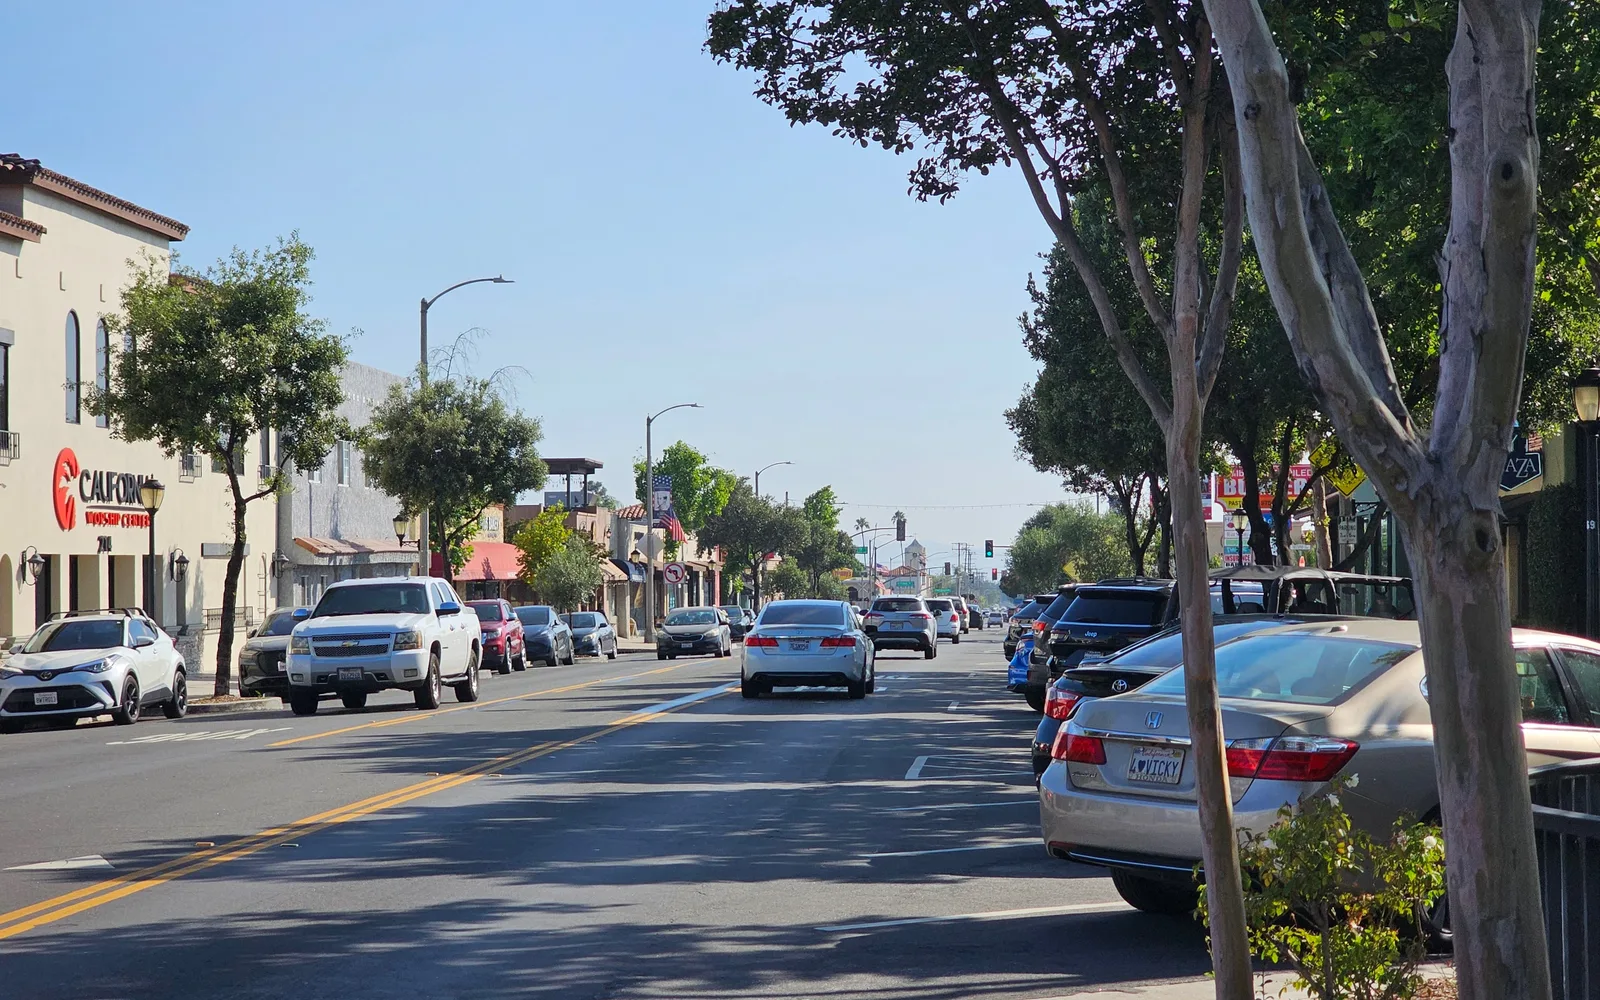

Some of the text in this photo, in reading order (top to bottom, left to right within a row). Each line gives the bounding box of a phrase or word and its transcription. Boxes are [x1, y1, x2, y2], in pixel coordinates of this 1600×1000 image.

[1505, 458, 1537, 478] AZA
[79, 469, 149, 505] CALIFORN
[85, 512, 121, 527] WORSHIP
